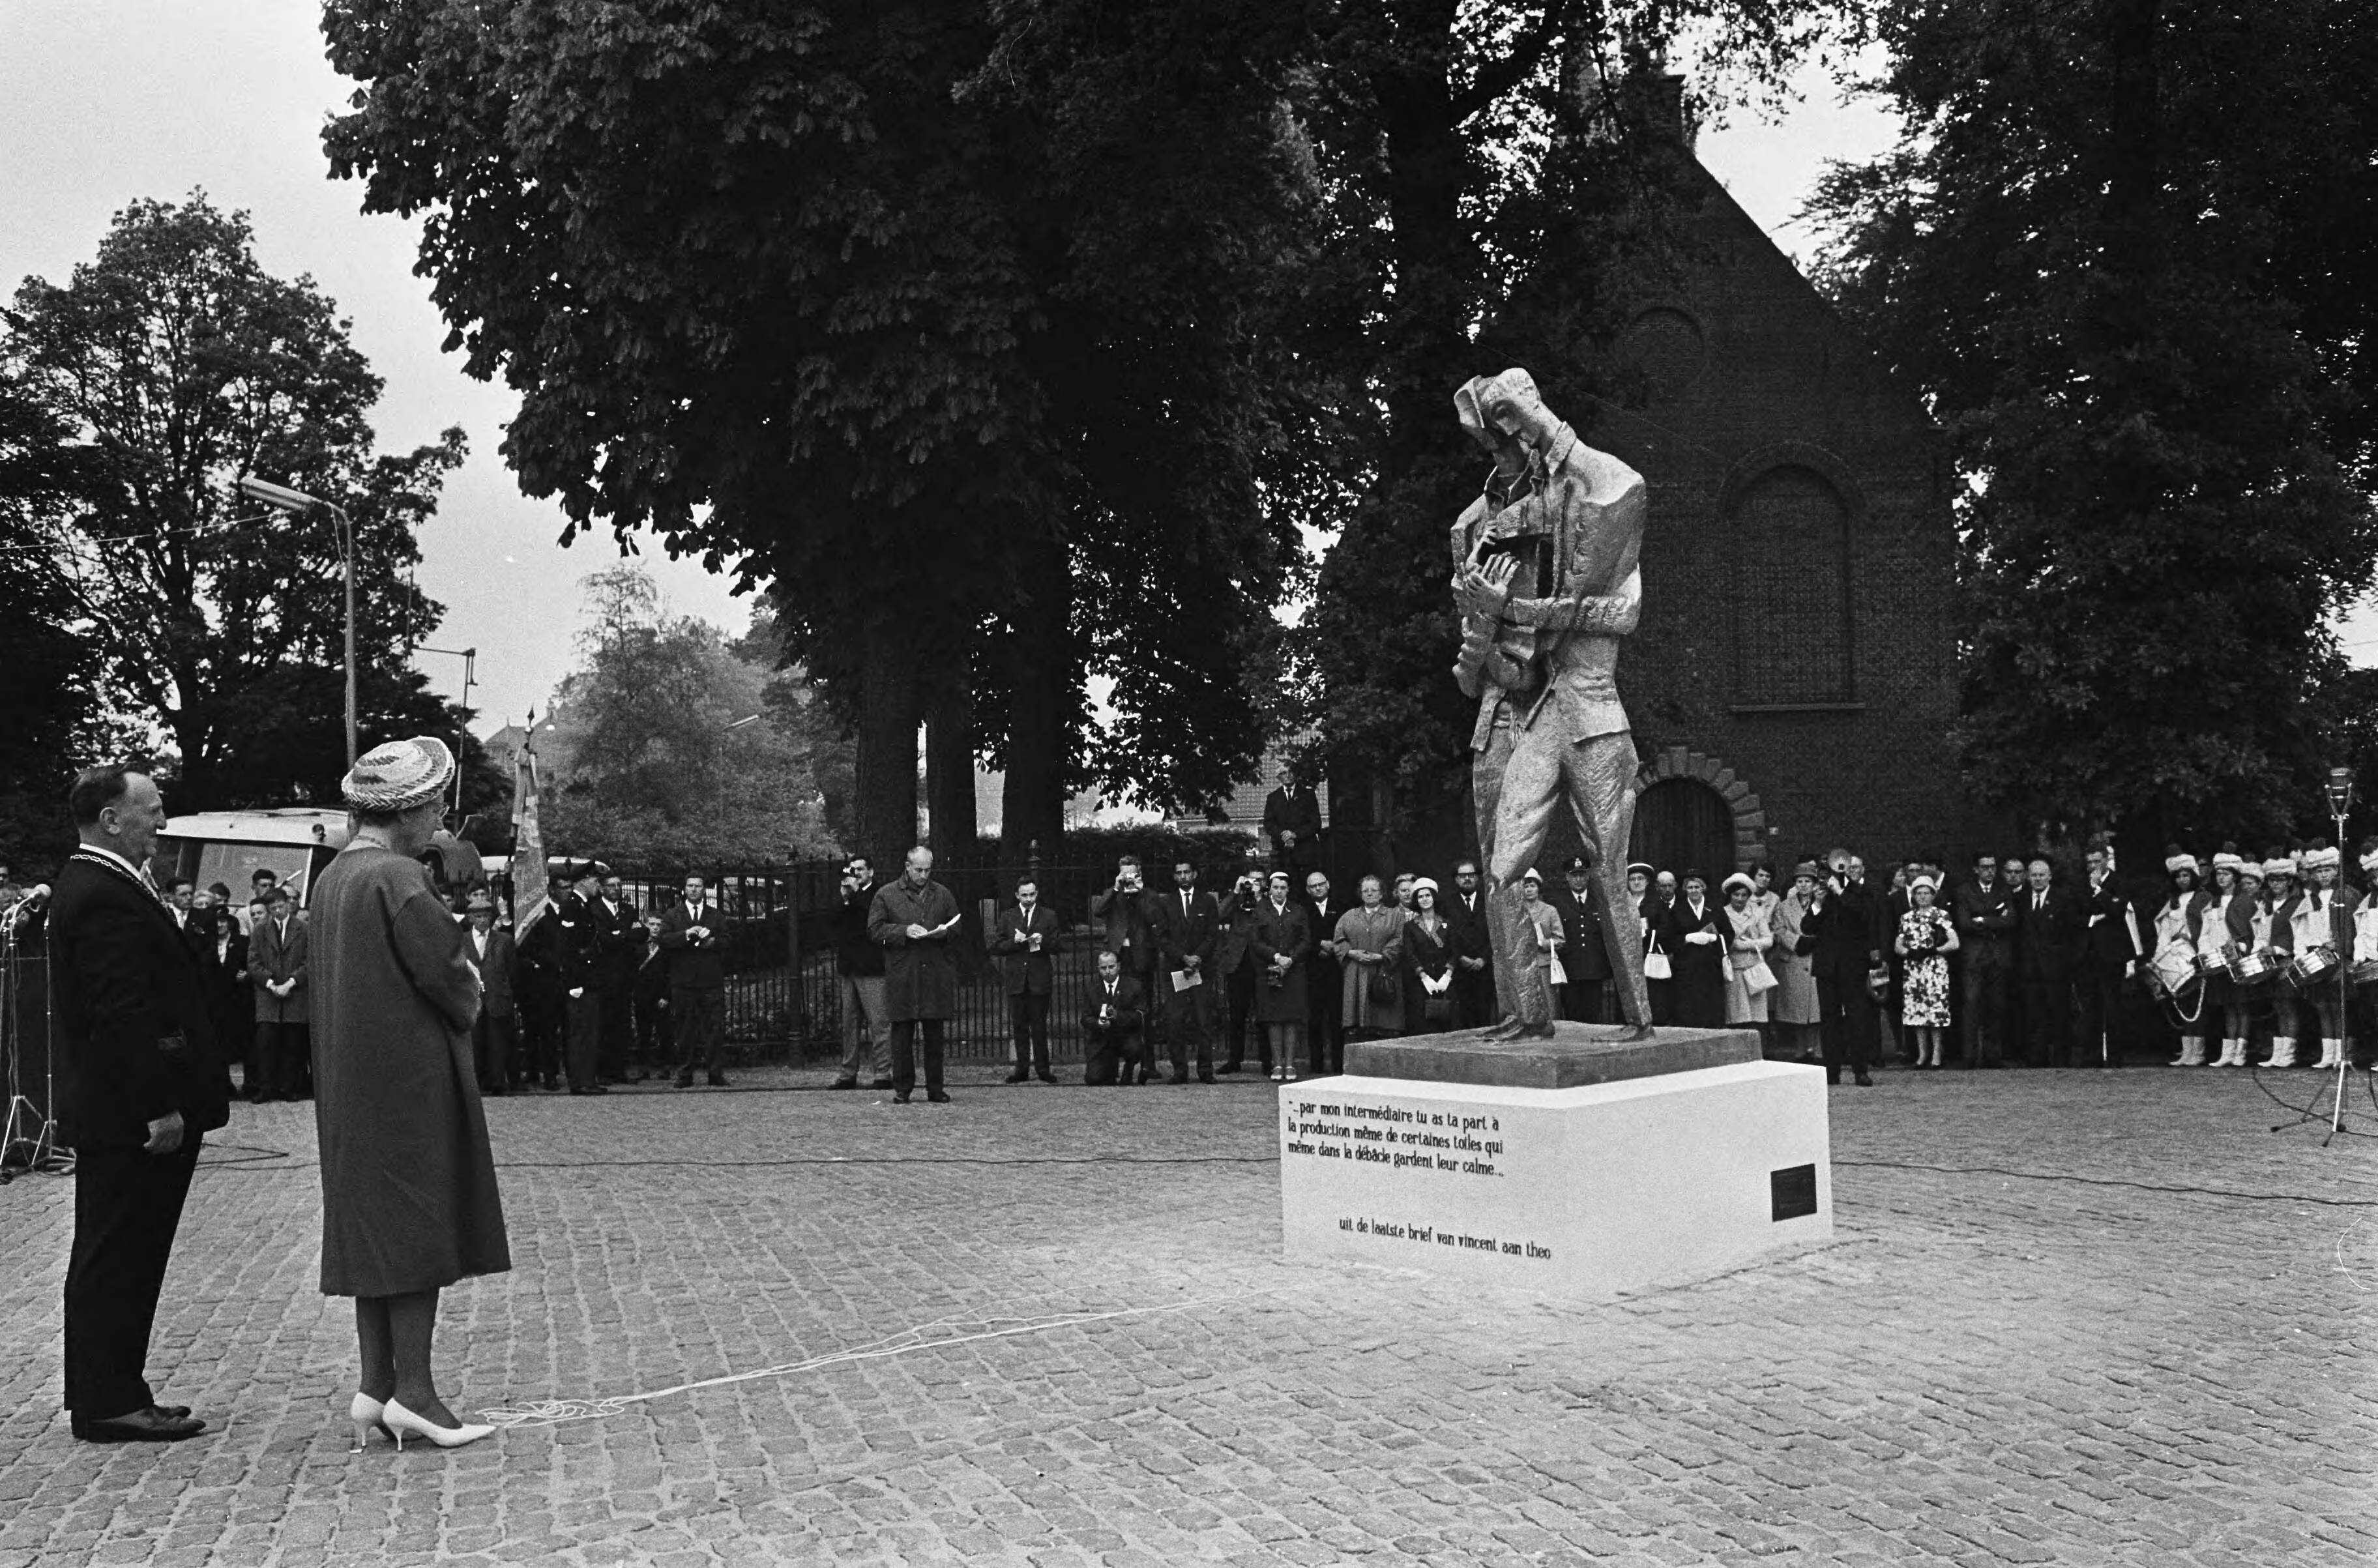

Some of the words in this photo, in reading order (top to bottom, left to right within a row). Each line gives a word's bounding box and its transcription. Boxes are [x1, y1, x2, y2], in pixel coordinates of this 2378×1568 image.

[1320, 1104, 1340, 1116] mon
[1344, 1103, 1413, 1122] intermédiaire
[1417, 1110, 1427, 1124] tu
[1432, 1114, 1443, 1125] as
[1448, 1112, 1458, 1127] ta
[1463, 1116, 1487, 1134] part
[1492, 1116, 1499, 1131] à
[1288, 1116, 1297, 1132] la
[1300, 1119, 1350, 1139] production
[1354, 1125, 1383, 1141] même
[1386, 1126, 1398, 1142] de
[1402, 1131, 1450, 1149] certaines
[1454, 1133, 1482, 1152] toiles
[1485, 1140, 1503, 1159] qui
[1288, 1140, 1315, 1155] même
[1318, 1140, 1340, 1158] dans
[1344, 1142, 1353, 1159] la
[1355, 1144, 1390, 1164] débâcle
[1394, 1150, 1434, 1168] gardent
[1437, 1152, 1459, 1171] leur
[1340, 1217, 1353, 1231] uit
[1357, 1217, 1368, 1233] de
[1372, 1218, 1405, 1238] laatste
[1408, 1223, 1432, 1243] brief
[1437, 1233, 1454, 1245] van
[1458, 1234, 1498, 1252] vincent
[1502, 1242, 1521, 1255] aan
[1526, 1240, 1551, 1259] theo
